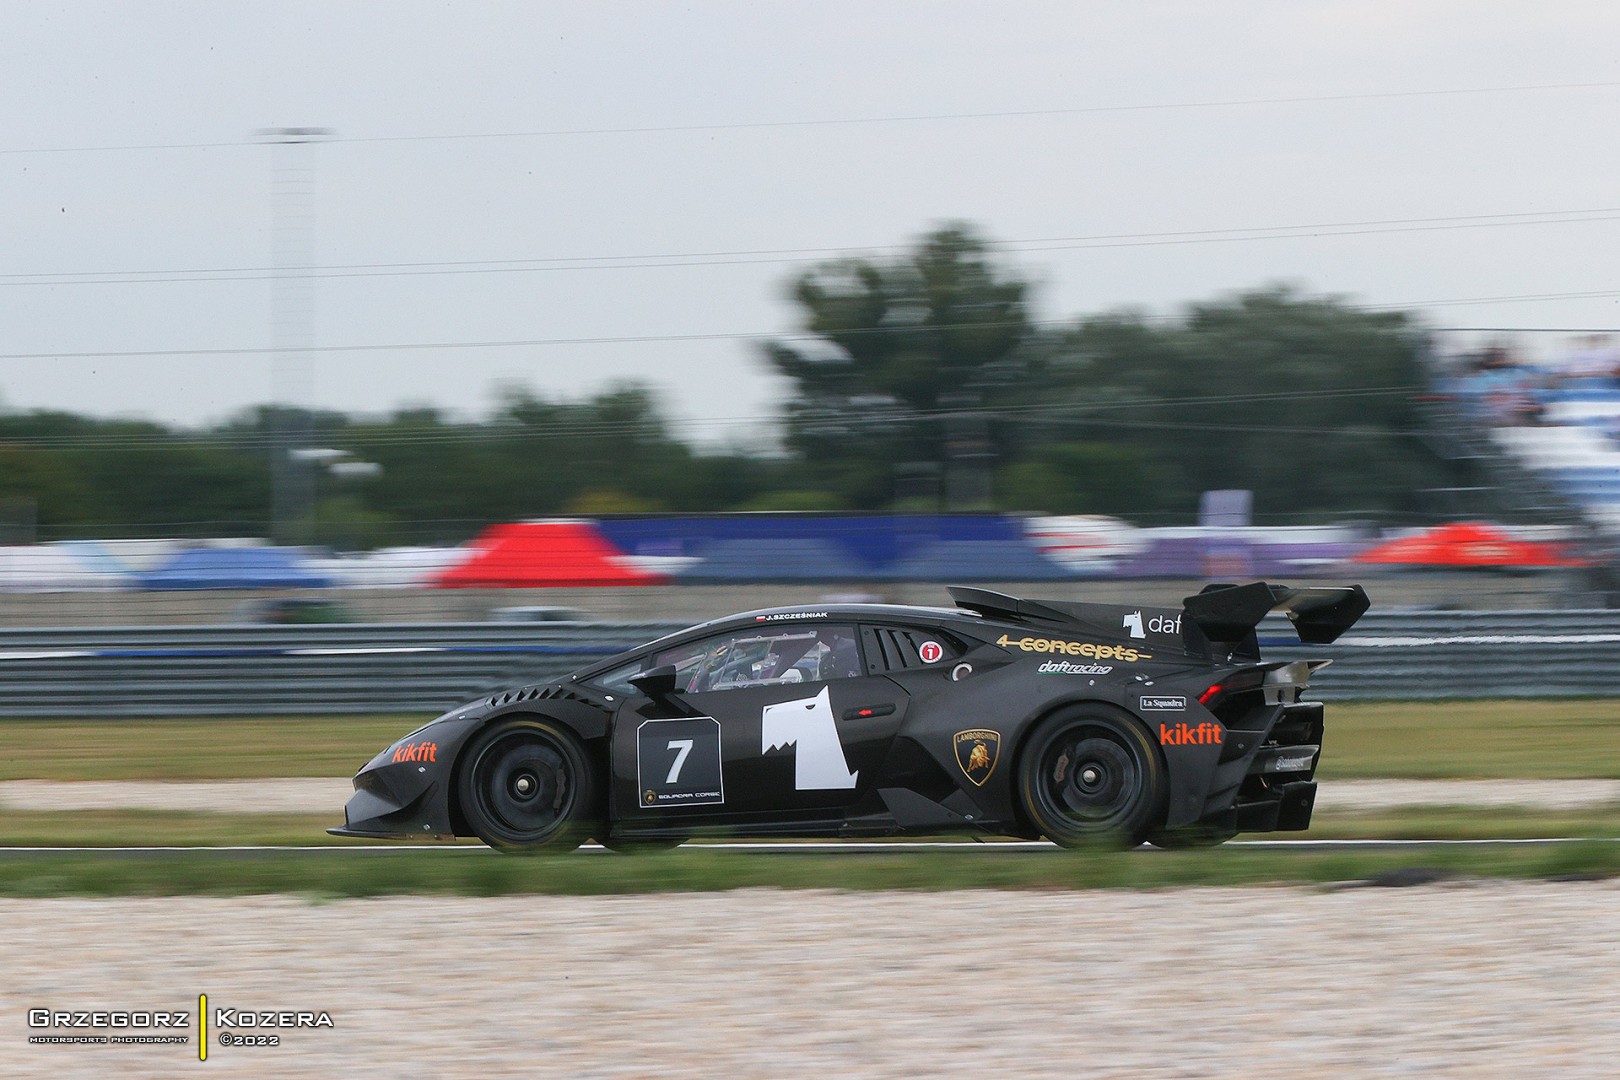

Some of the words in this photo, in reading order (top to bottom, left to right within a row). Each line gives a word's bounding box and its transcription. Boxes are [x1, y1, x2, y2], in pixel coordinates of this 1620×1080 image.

[1038, 660, 1113, 675] daftracing
[1143, 699, 1153, 707] La
[1153, 699, 1183, 708] Squadra
[1160, 722, 1222, 745] kikfit
[391, 741, 437, 763] kikfit
[666, 739, 693, 783] 7
